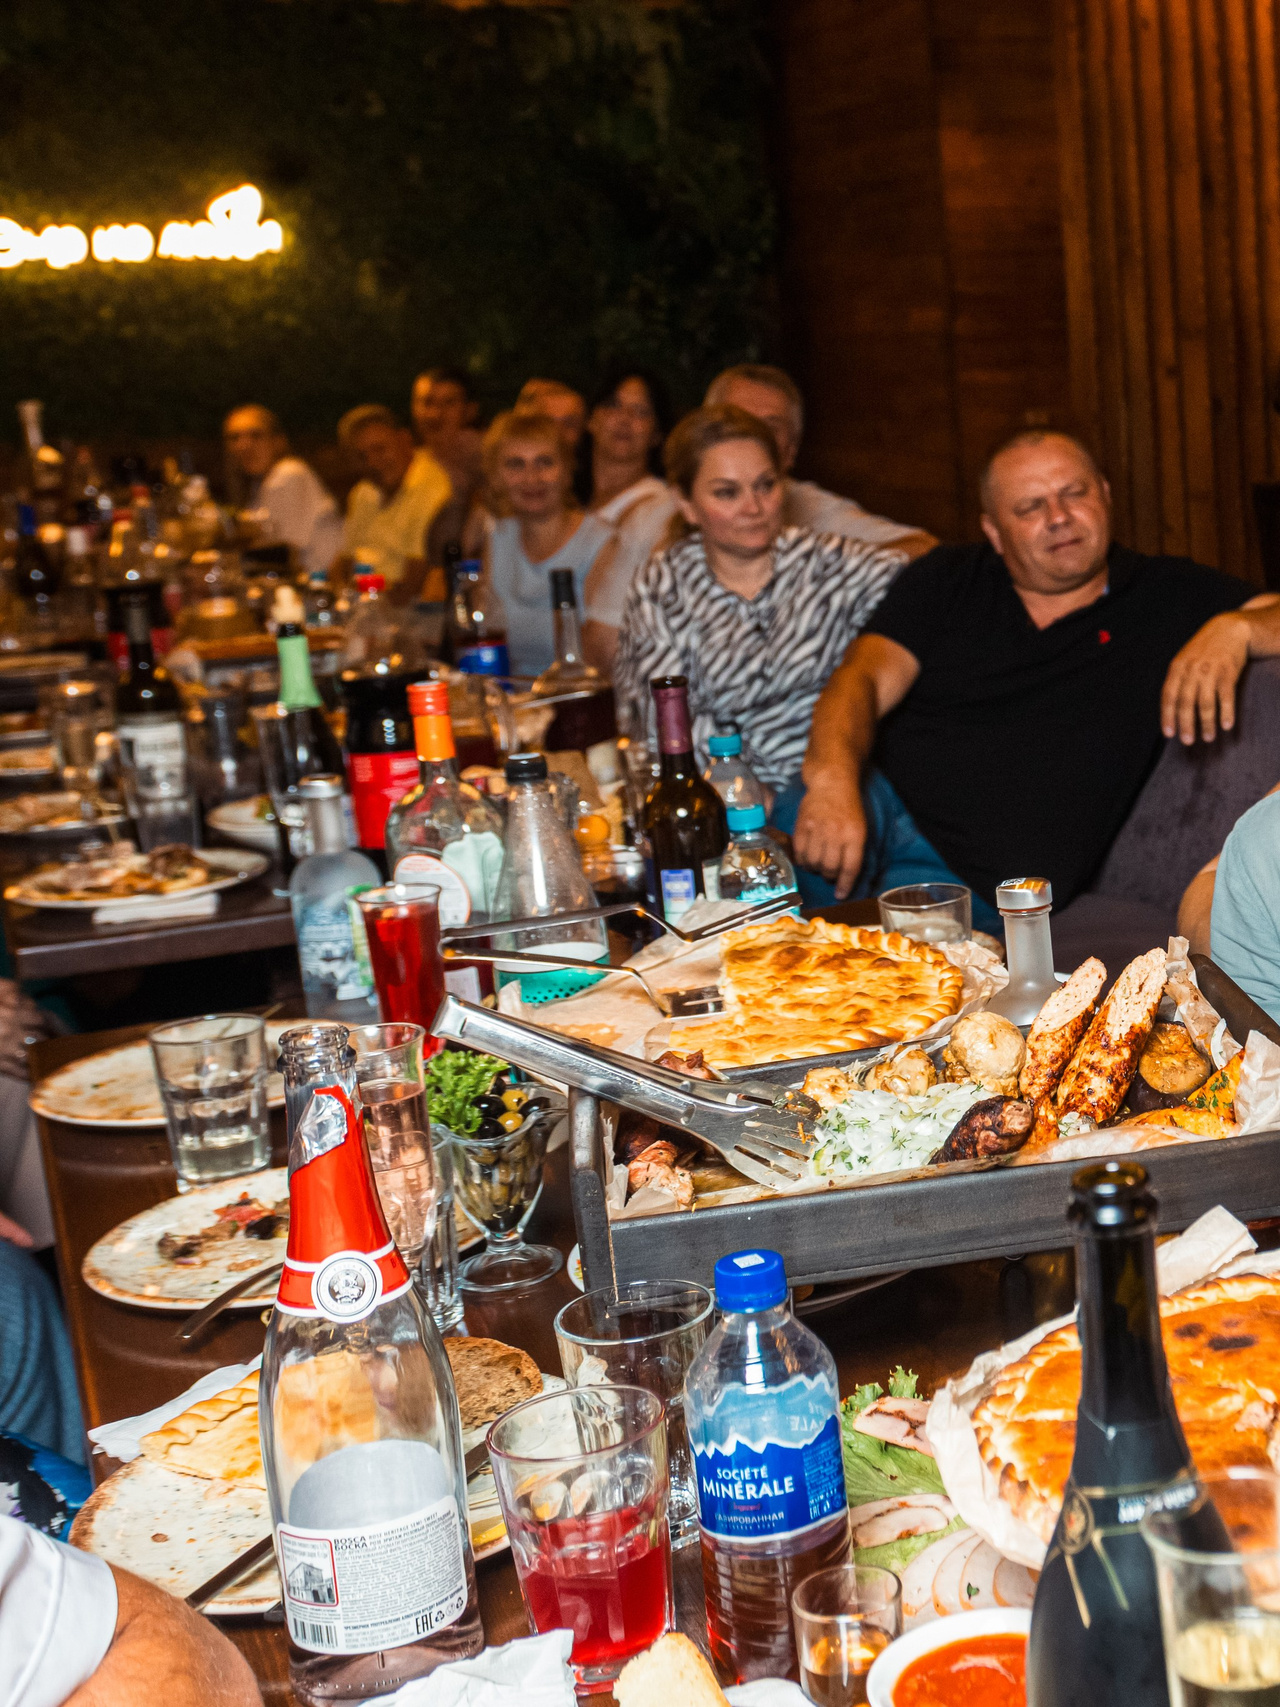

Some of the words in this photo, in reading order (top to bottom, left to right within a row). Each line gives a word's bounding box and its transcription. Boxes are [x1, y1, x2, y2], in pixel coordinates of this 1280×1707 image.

[716, 1464, 768, 1481] SOCIÉTÉ
[702, 1475, 795, 1501] MINÉRALE
[333, 1535, 366, 1545] BOSCA
[334, 1541, 367, 1551] БОСКА
[415, 1611, 434, 1635] EAC
